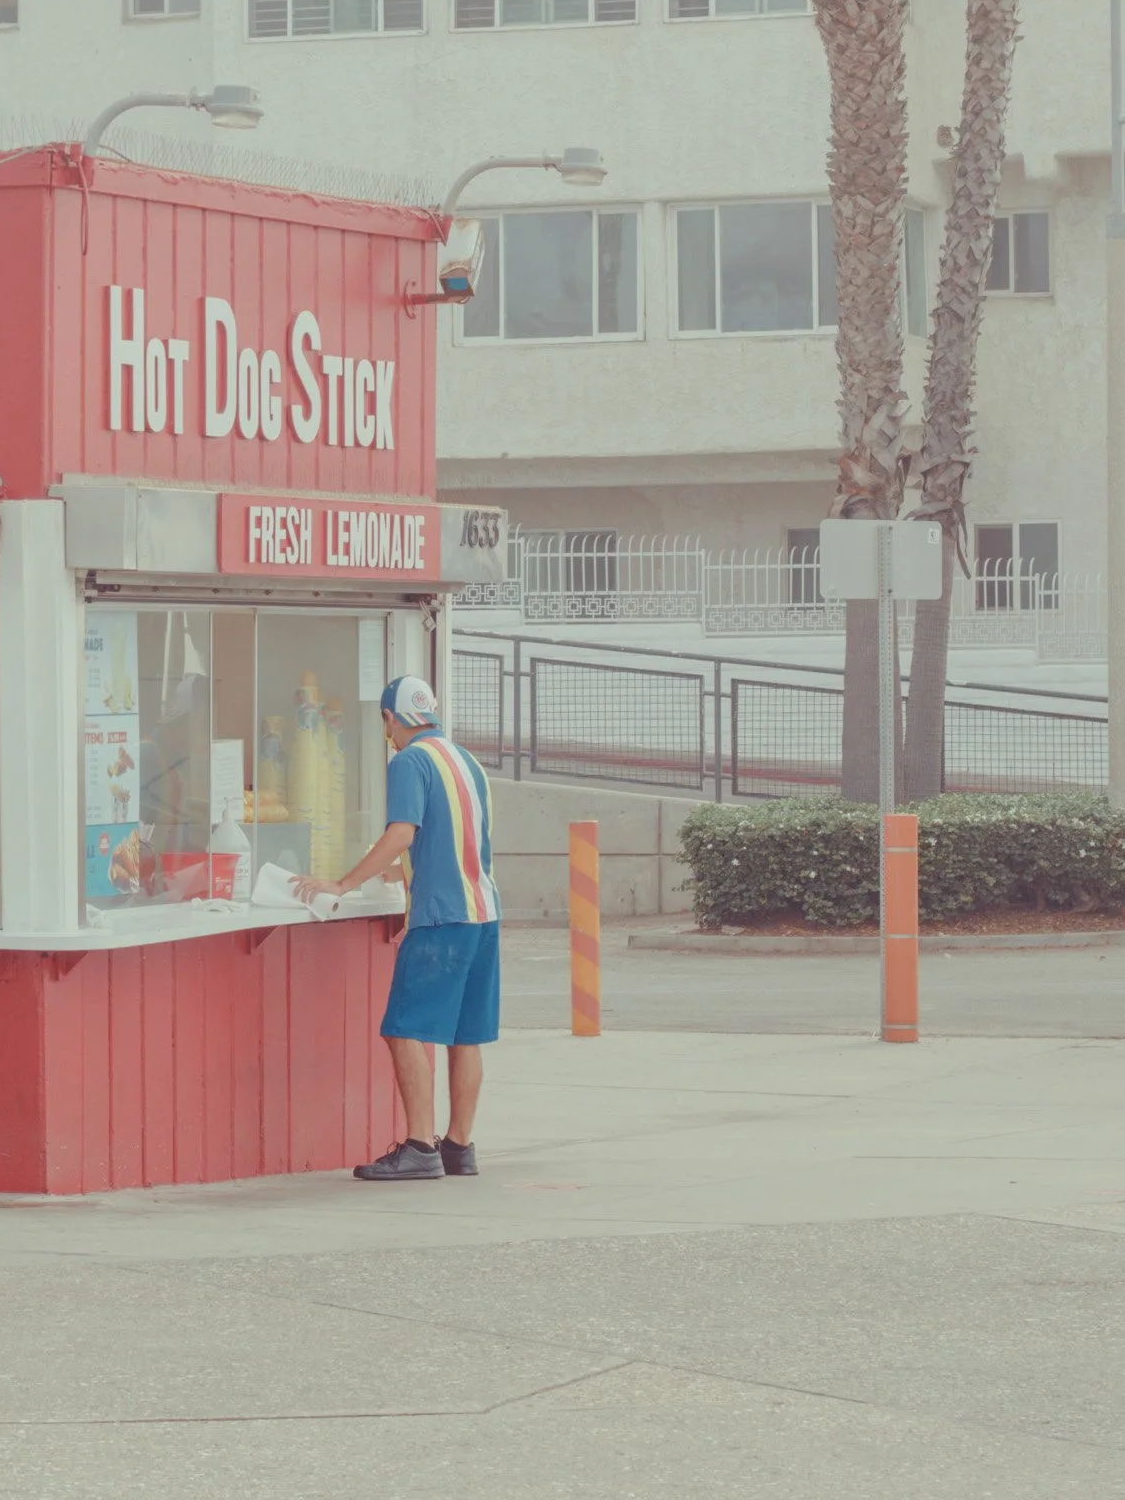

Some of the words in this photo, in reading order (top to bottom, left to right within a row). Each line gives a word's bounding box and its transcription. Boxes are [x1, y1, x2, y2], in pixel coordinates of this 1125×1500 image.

[110, 285, 190, 435] HOT
[204, 296, 283, 441] DOG
[291, 310, 395, 450] STICK
[249, 506, 313, 565] FRESH
[326, 510, 426, 570] LEMONADE
[459, 509, 502, 549] 1633
